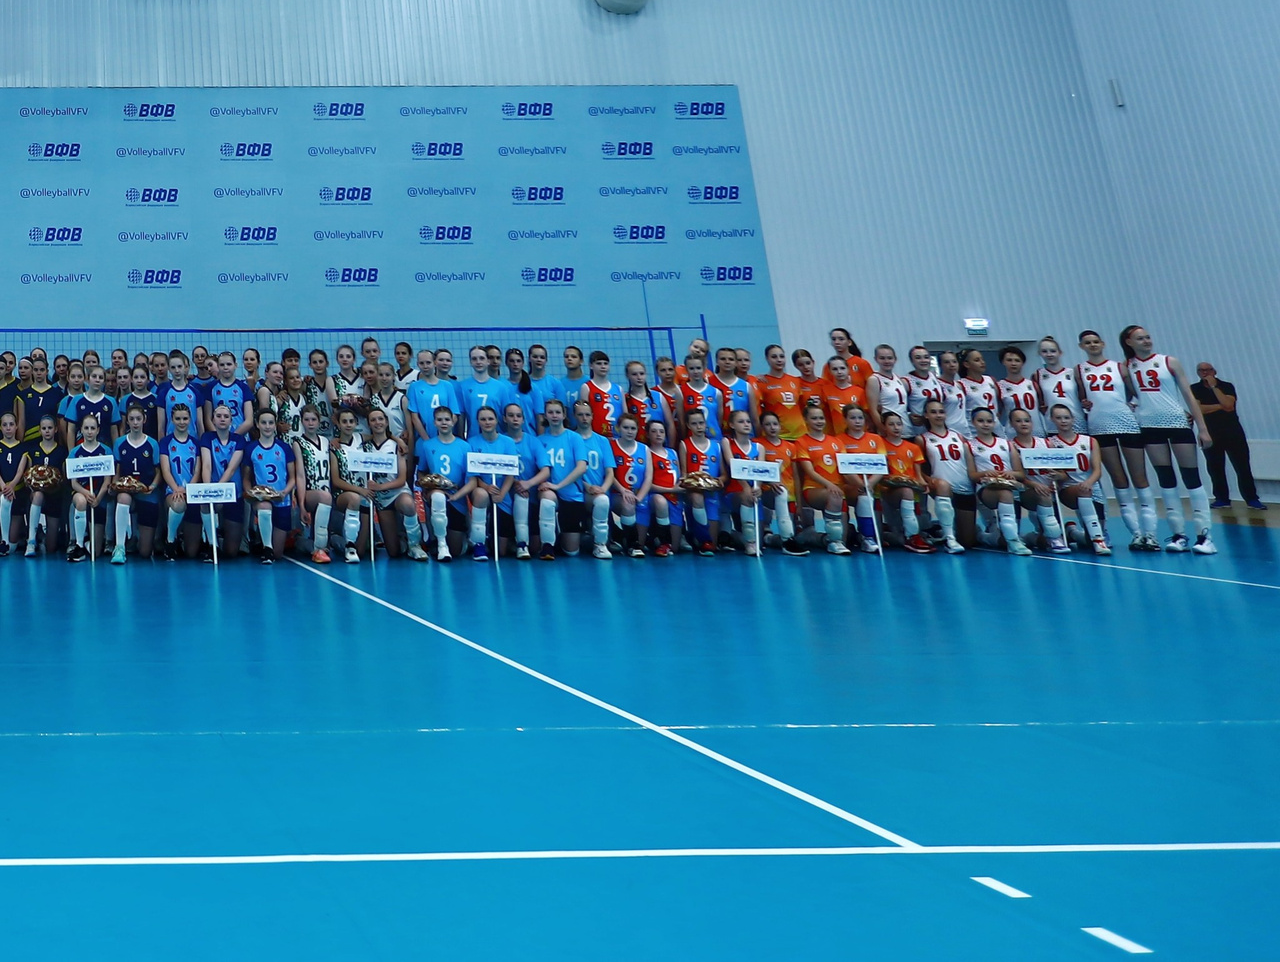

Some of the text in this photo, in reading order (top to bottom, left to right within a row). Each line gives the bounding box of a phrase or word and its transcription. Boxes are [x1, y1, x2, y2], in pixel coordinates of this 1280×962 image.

[20, 107, 88, 117] @VolleyballVFV
[138, 103, 175, 117] ВФВ
[210, 107, 278, 117] @VolleyballVFV
[328, 103, 364, 116] ВФВ
[400, 107, 467, 117] @VolleyballVFV
[517, 102, 553, 116] ВФВ
[588, 106, 656, 116] @VolleyballVFV
[689, 102, 725, 116] ВФВ
[43, 143, 80, 157] ВФВ
[116, 147, 185, 158] @VolleyballVFV
[235, 143, 272, 157] ВФВ
[308, 146, 376, 157] @VolleyballVFV
[427, 142, 463, 156] ВФВ
[498, 146, 567, 156] @VolleyballVFV
[616, 142, 653, 156] ВФВ
[672, 146, 740, 156] @VolleyballVFV
[20, 188, 90, 198] @VolleyballVFV
[141, 188, 178, 202] ВФВ
[214, 188, 283, 198] @VolleyballVFV
[334, 187, 371, 201] ВФВ
[407, 187, 476, 197] @VolleyballVFV
[527, 186, 564, 201] ВФВ
[599, 187, 668, 197] @VolleyballVFV
[702, 186, 739, 200] ВФВ
[44, 227, 82, 242] ВФВ
[118, 232, 188, 242] @VolleyballVFV
[239, 226, 277, 241] ВФВ
[314, 230, 383, 241] @VolleyballVFV
[434, 226, 472, 240] ВФВ
[508, 230, 578, 240] @VolleyballVFV
[628, 225, 665, 240] ВФВ
[685, 229, 755, 240] @VolleyballVFV
[21, 274, 92, 284] @VolleyballVFV
[142, 269, 181, 284] ВФВ
[218, 273, 288, 283] @VolleyballVFV
[340, 268, 378, 283] ВФВ
[415, 272, 485, 283] @VolleyballVFV
[536, 267, 574, 282] ВФВ
[611, 271, 681, 282] @VolleyballVFV
[715, 266, 753, 281] ВФВ
[1086, 373, 1115, 392] 22
[1134, 369, 1161, 389] 13
[895, 387, 905, 405] 1
[1052, 381, 1067, 398] 4
[38, 396, 44, 407] 7
[430, 394, 440, 409] 4
[982, 392, 995, 410] 2
[1010, 392, 1035, 411] 10
[90, 412, 101, 425] 1
[602, 403, 616, 422] 2
[6, 452, 13, 464] 4
[546, 447, 566, 468] 14
[936, 443, 962, 462] 16
[131, 458, 138, 472] 1
[171, 456, 195, 476] 11
[439, 454, 451, 475] 3
[822, 454, 834, 466] 6
[989, 453, 1005, 472] 9
[264, 463, 278, 484] 3
[624, 465, 638, 485] 6
